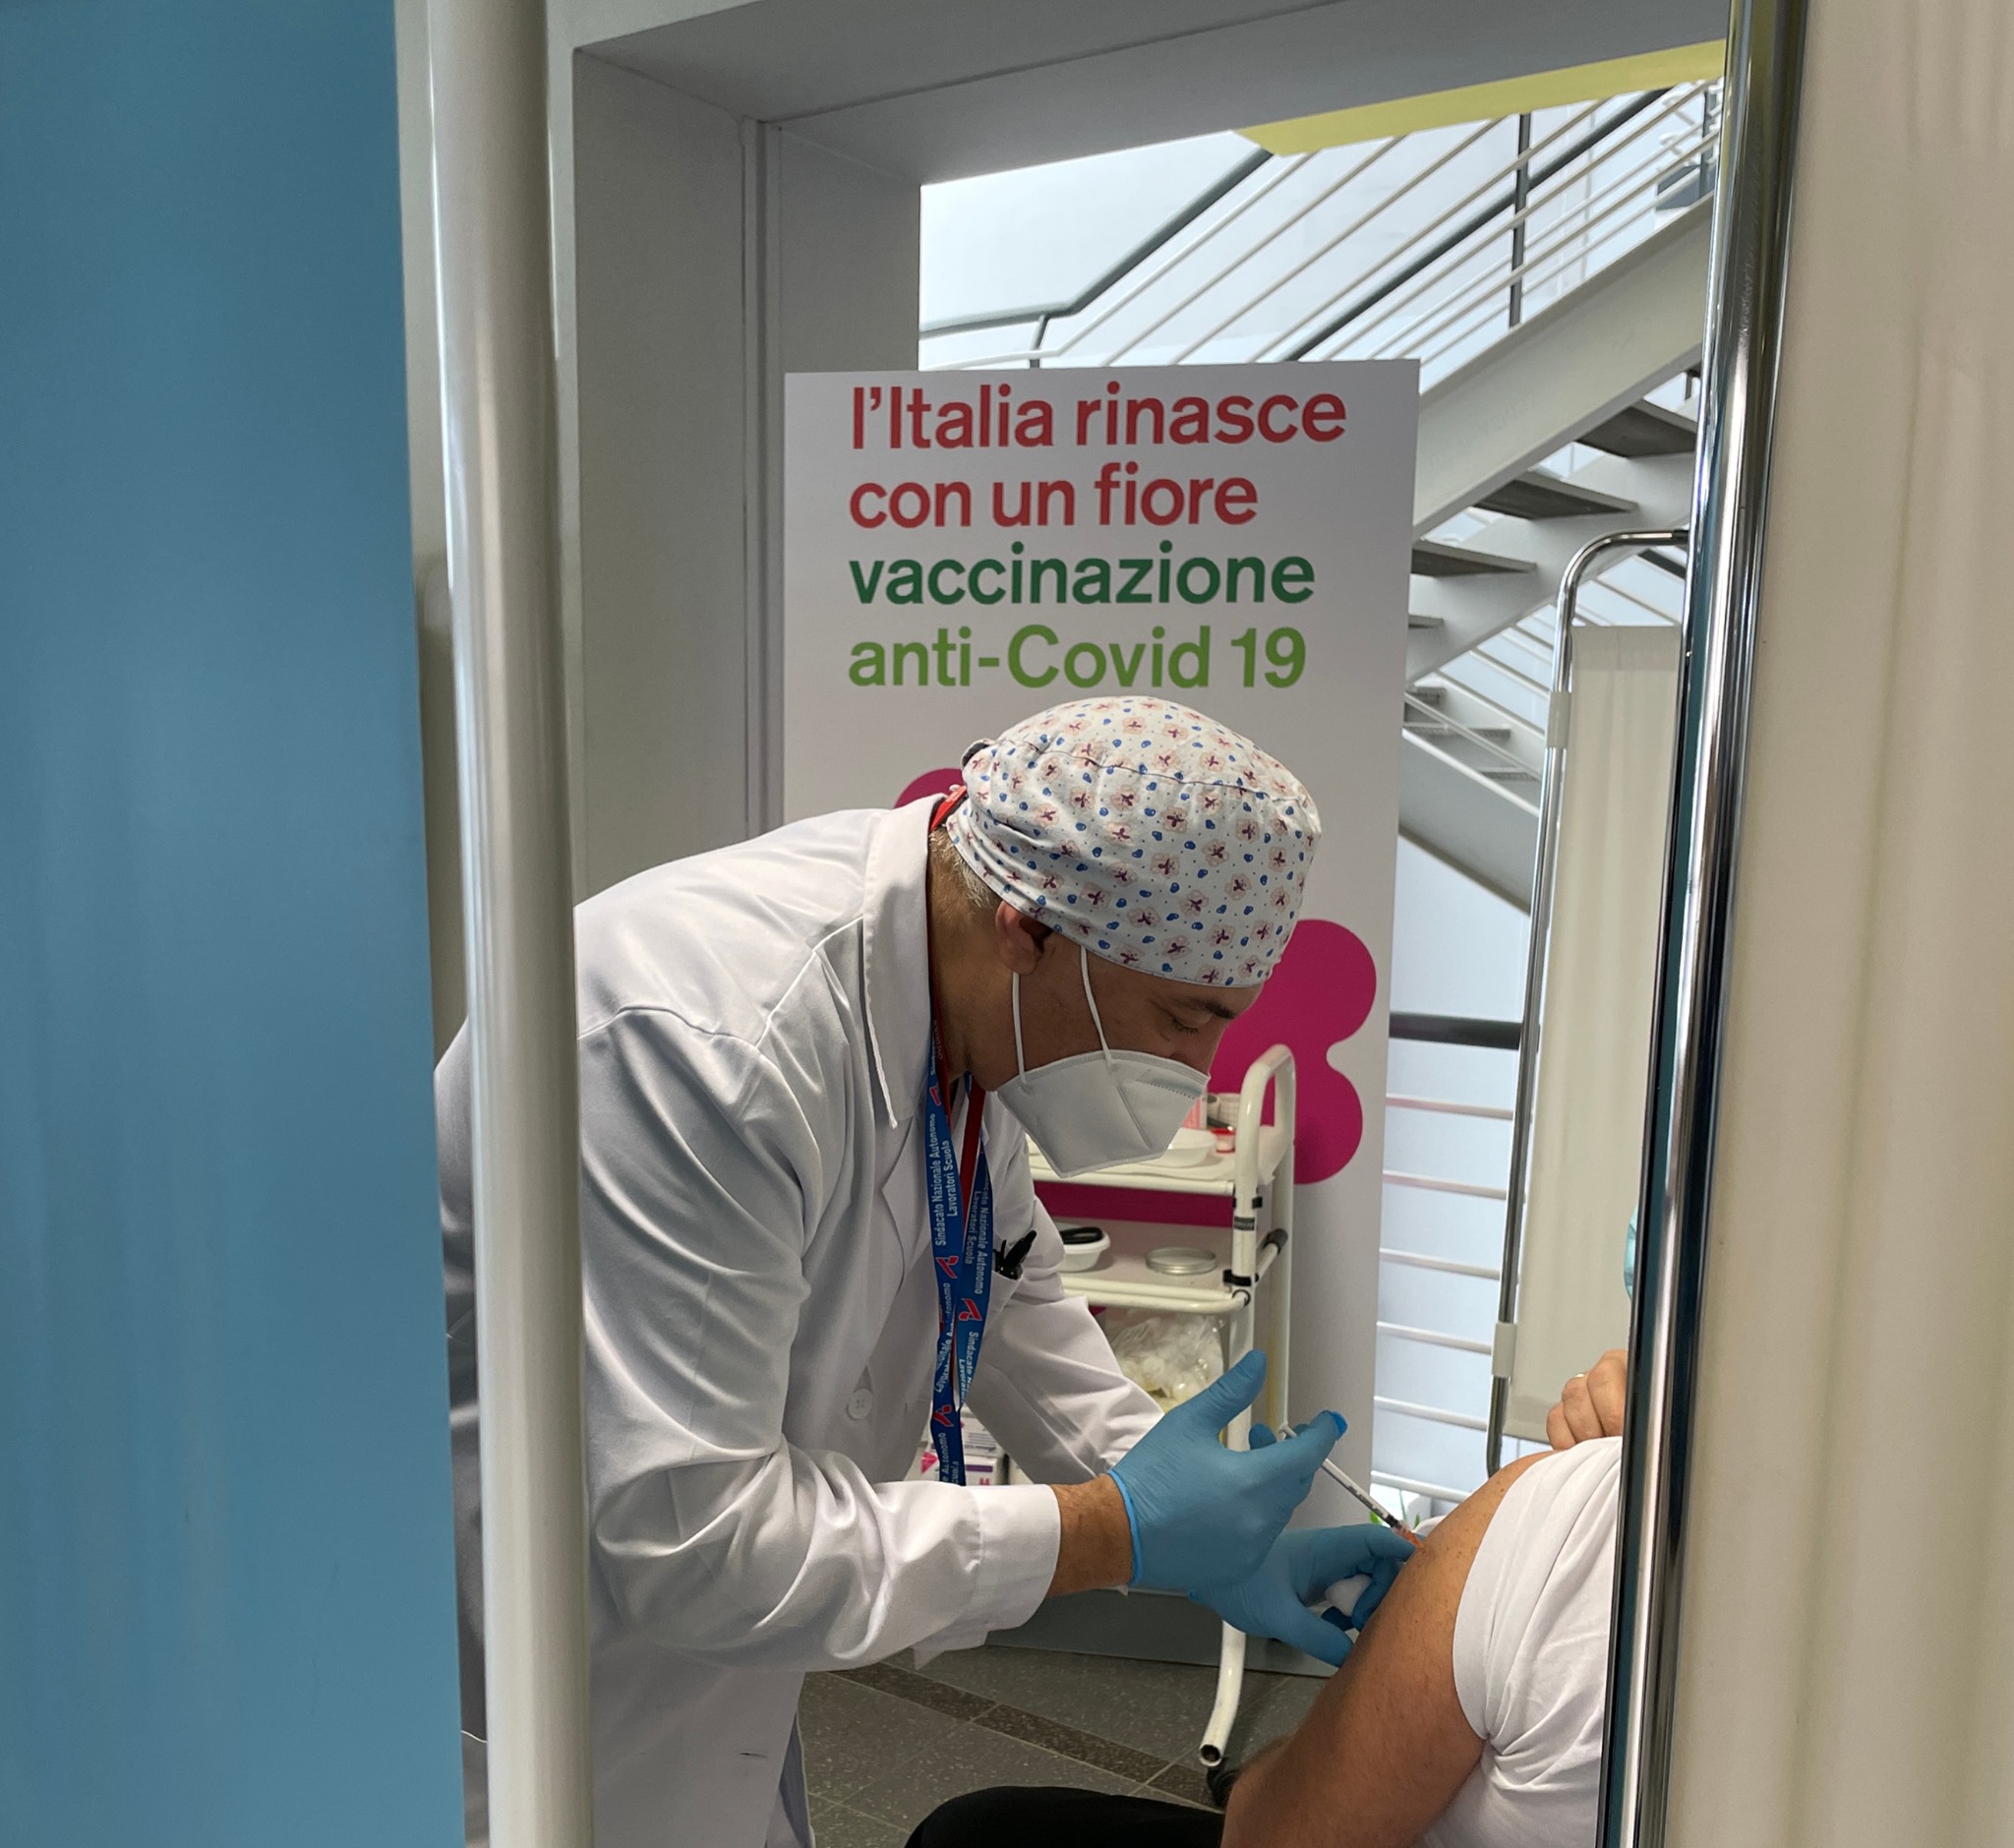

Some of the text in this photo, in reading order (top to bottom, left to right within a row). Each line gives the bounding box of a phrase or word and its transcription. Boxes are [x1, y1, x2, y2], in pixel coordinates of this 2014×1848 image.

[853, 381, 1347, 450] l'Italia rinasce
[849, 461, 1258, 528] con un fiore
[850, 541, 1315, 604] vaccinazione
[849, 625, 1306, 687] anti-Covid 19
[928, 1113, 947, 1246] Sindacato Nazionale Autonomo
[941, 1140, 958, 1217] Lavoratori Scuola
[965, 1190, 982, 1265] Lavoratori Scuola
[977, 1207, 989, 1249] Nazionale
[975, 1250, 987, 1295] Autonomo
[966, 1332, 979, 1375] Sindacato
